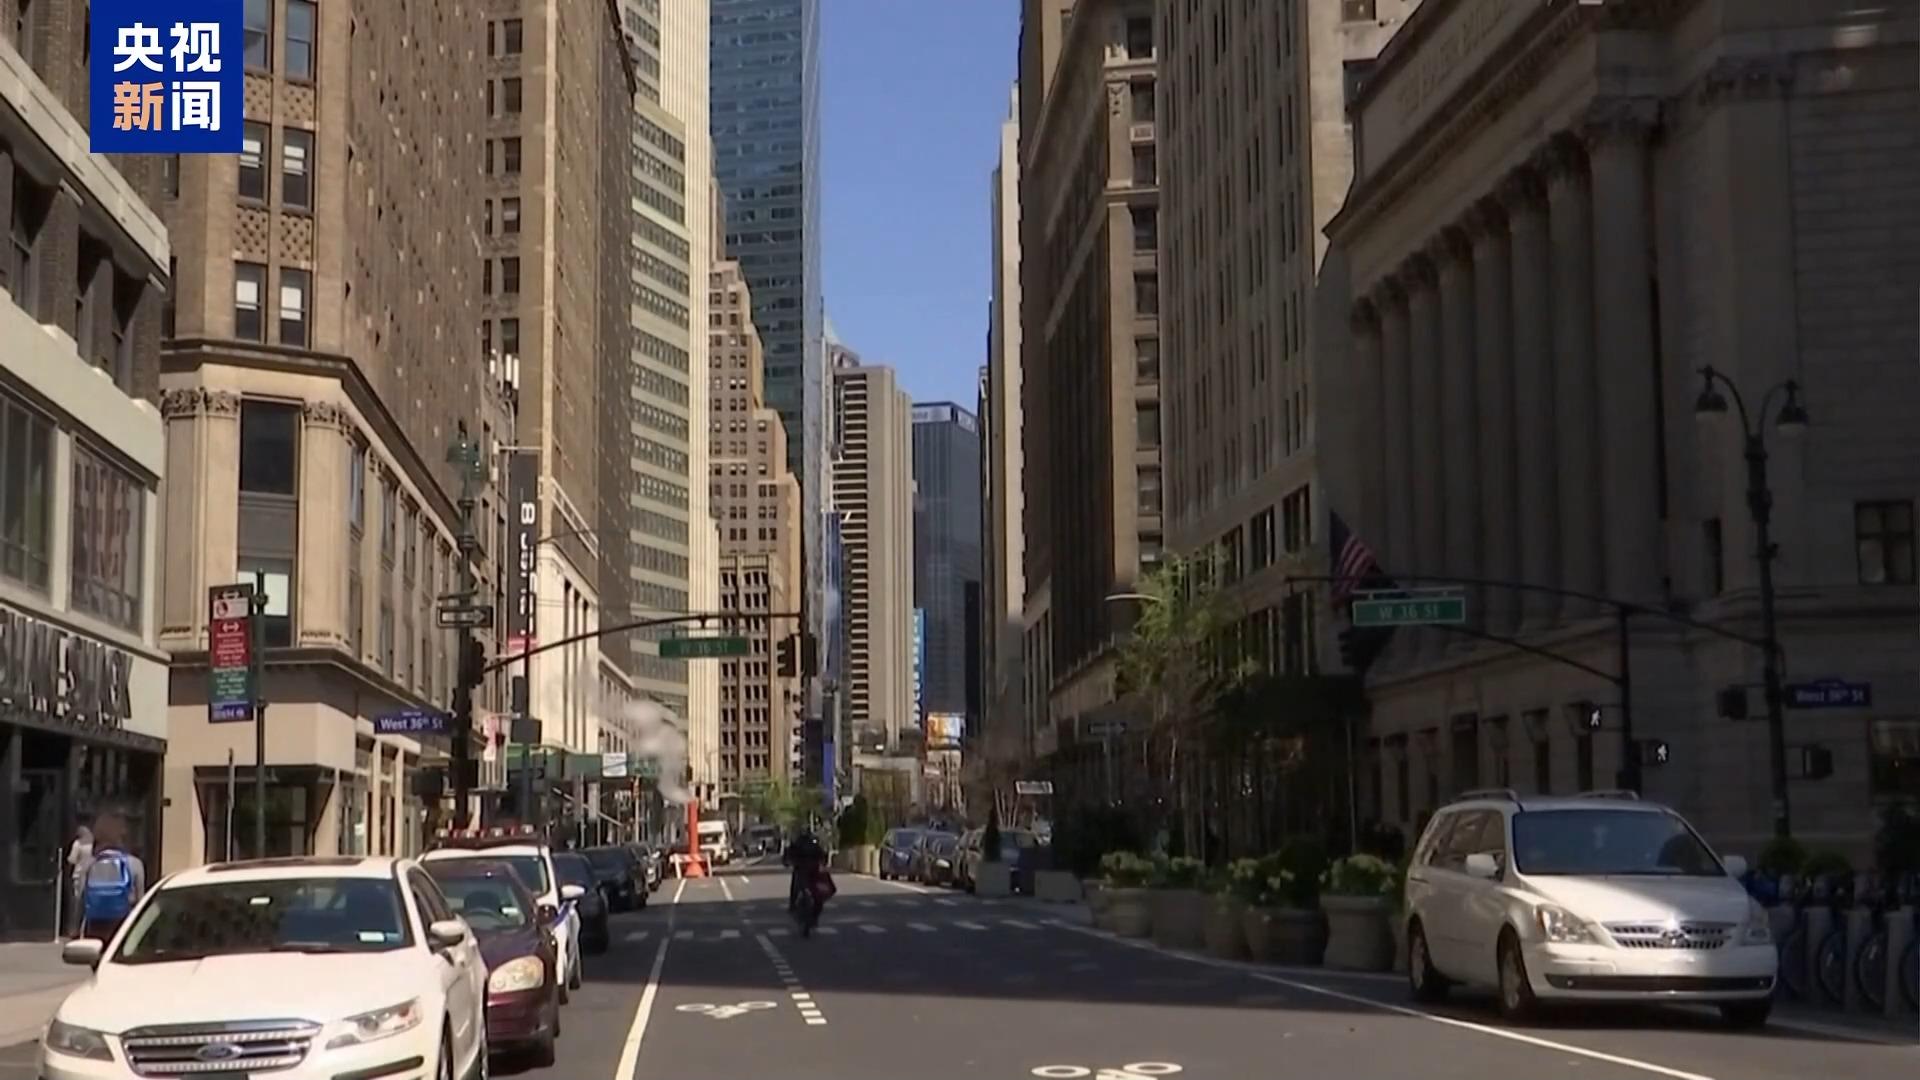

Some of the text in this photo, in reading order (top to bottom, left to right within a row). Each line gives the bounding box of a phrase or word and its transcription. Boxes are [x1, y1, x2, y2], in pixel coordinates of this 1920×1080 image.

[1379, 606, 1392, 619] W
[380, 718, 408, 730] West
[432, 717, 443, 729] St
